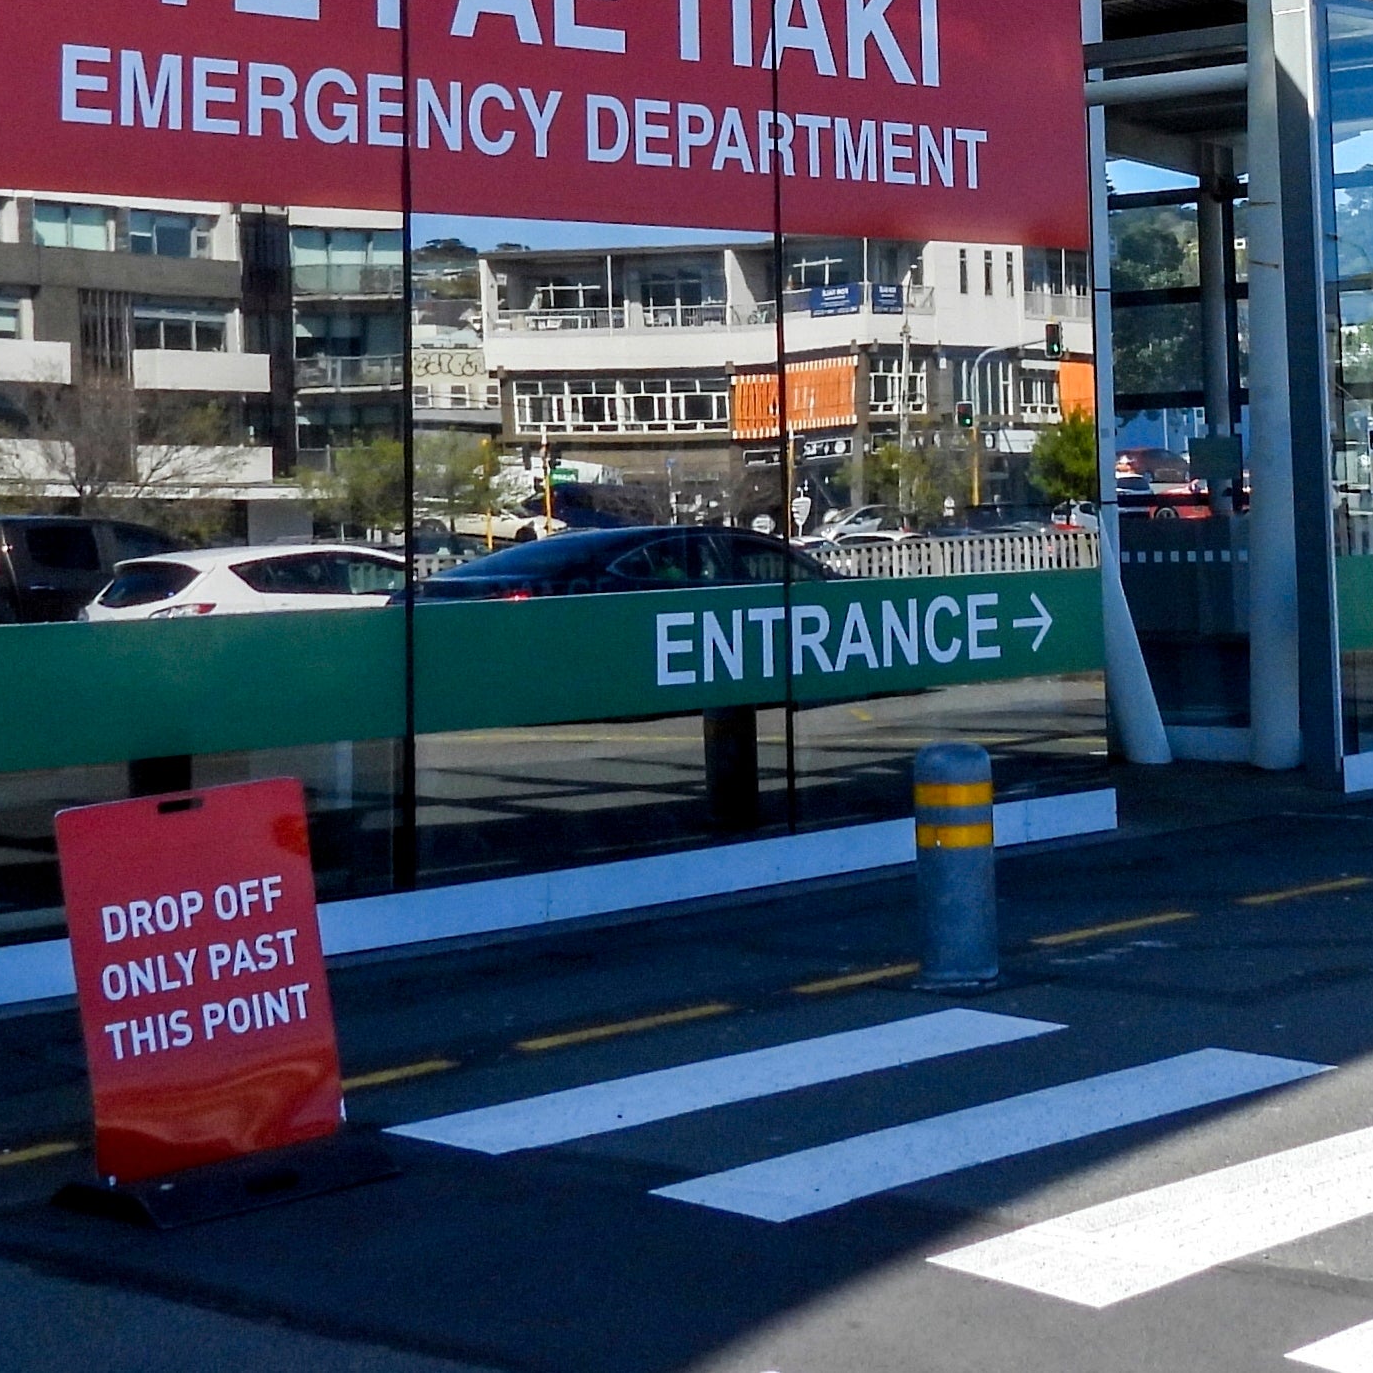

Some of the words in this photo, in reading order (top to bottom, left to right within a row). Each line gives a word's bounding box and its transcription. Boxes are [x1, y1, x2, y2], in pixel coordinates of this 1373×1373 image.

[61, 44, 562, 159] EMERGENCY
[587, 94, 987, 190] DEPARTMENT
[656, 593, 1001, 686] ENTRANCE
[101, 890, 204, 943] DROP
[214, 875, 282, 921] OFF
[102, 947, 197, 1001] ONLY
[208, 928, 298, 981] PAST
[104, 1009, 193, 1060] THIS
[202, 982, 310, 1040] POINT
